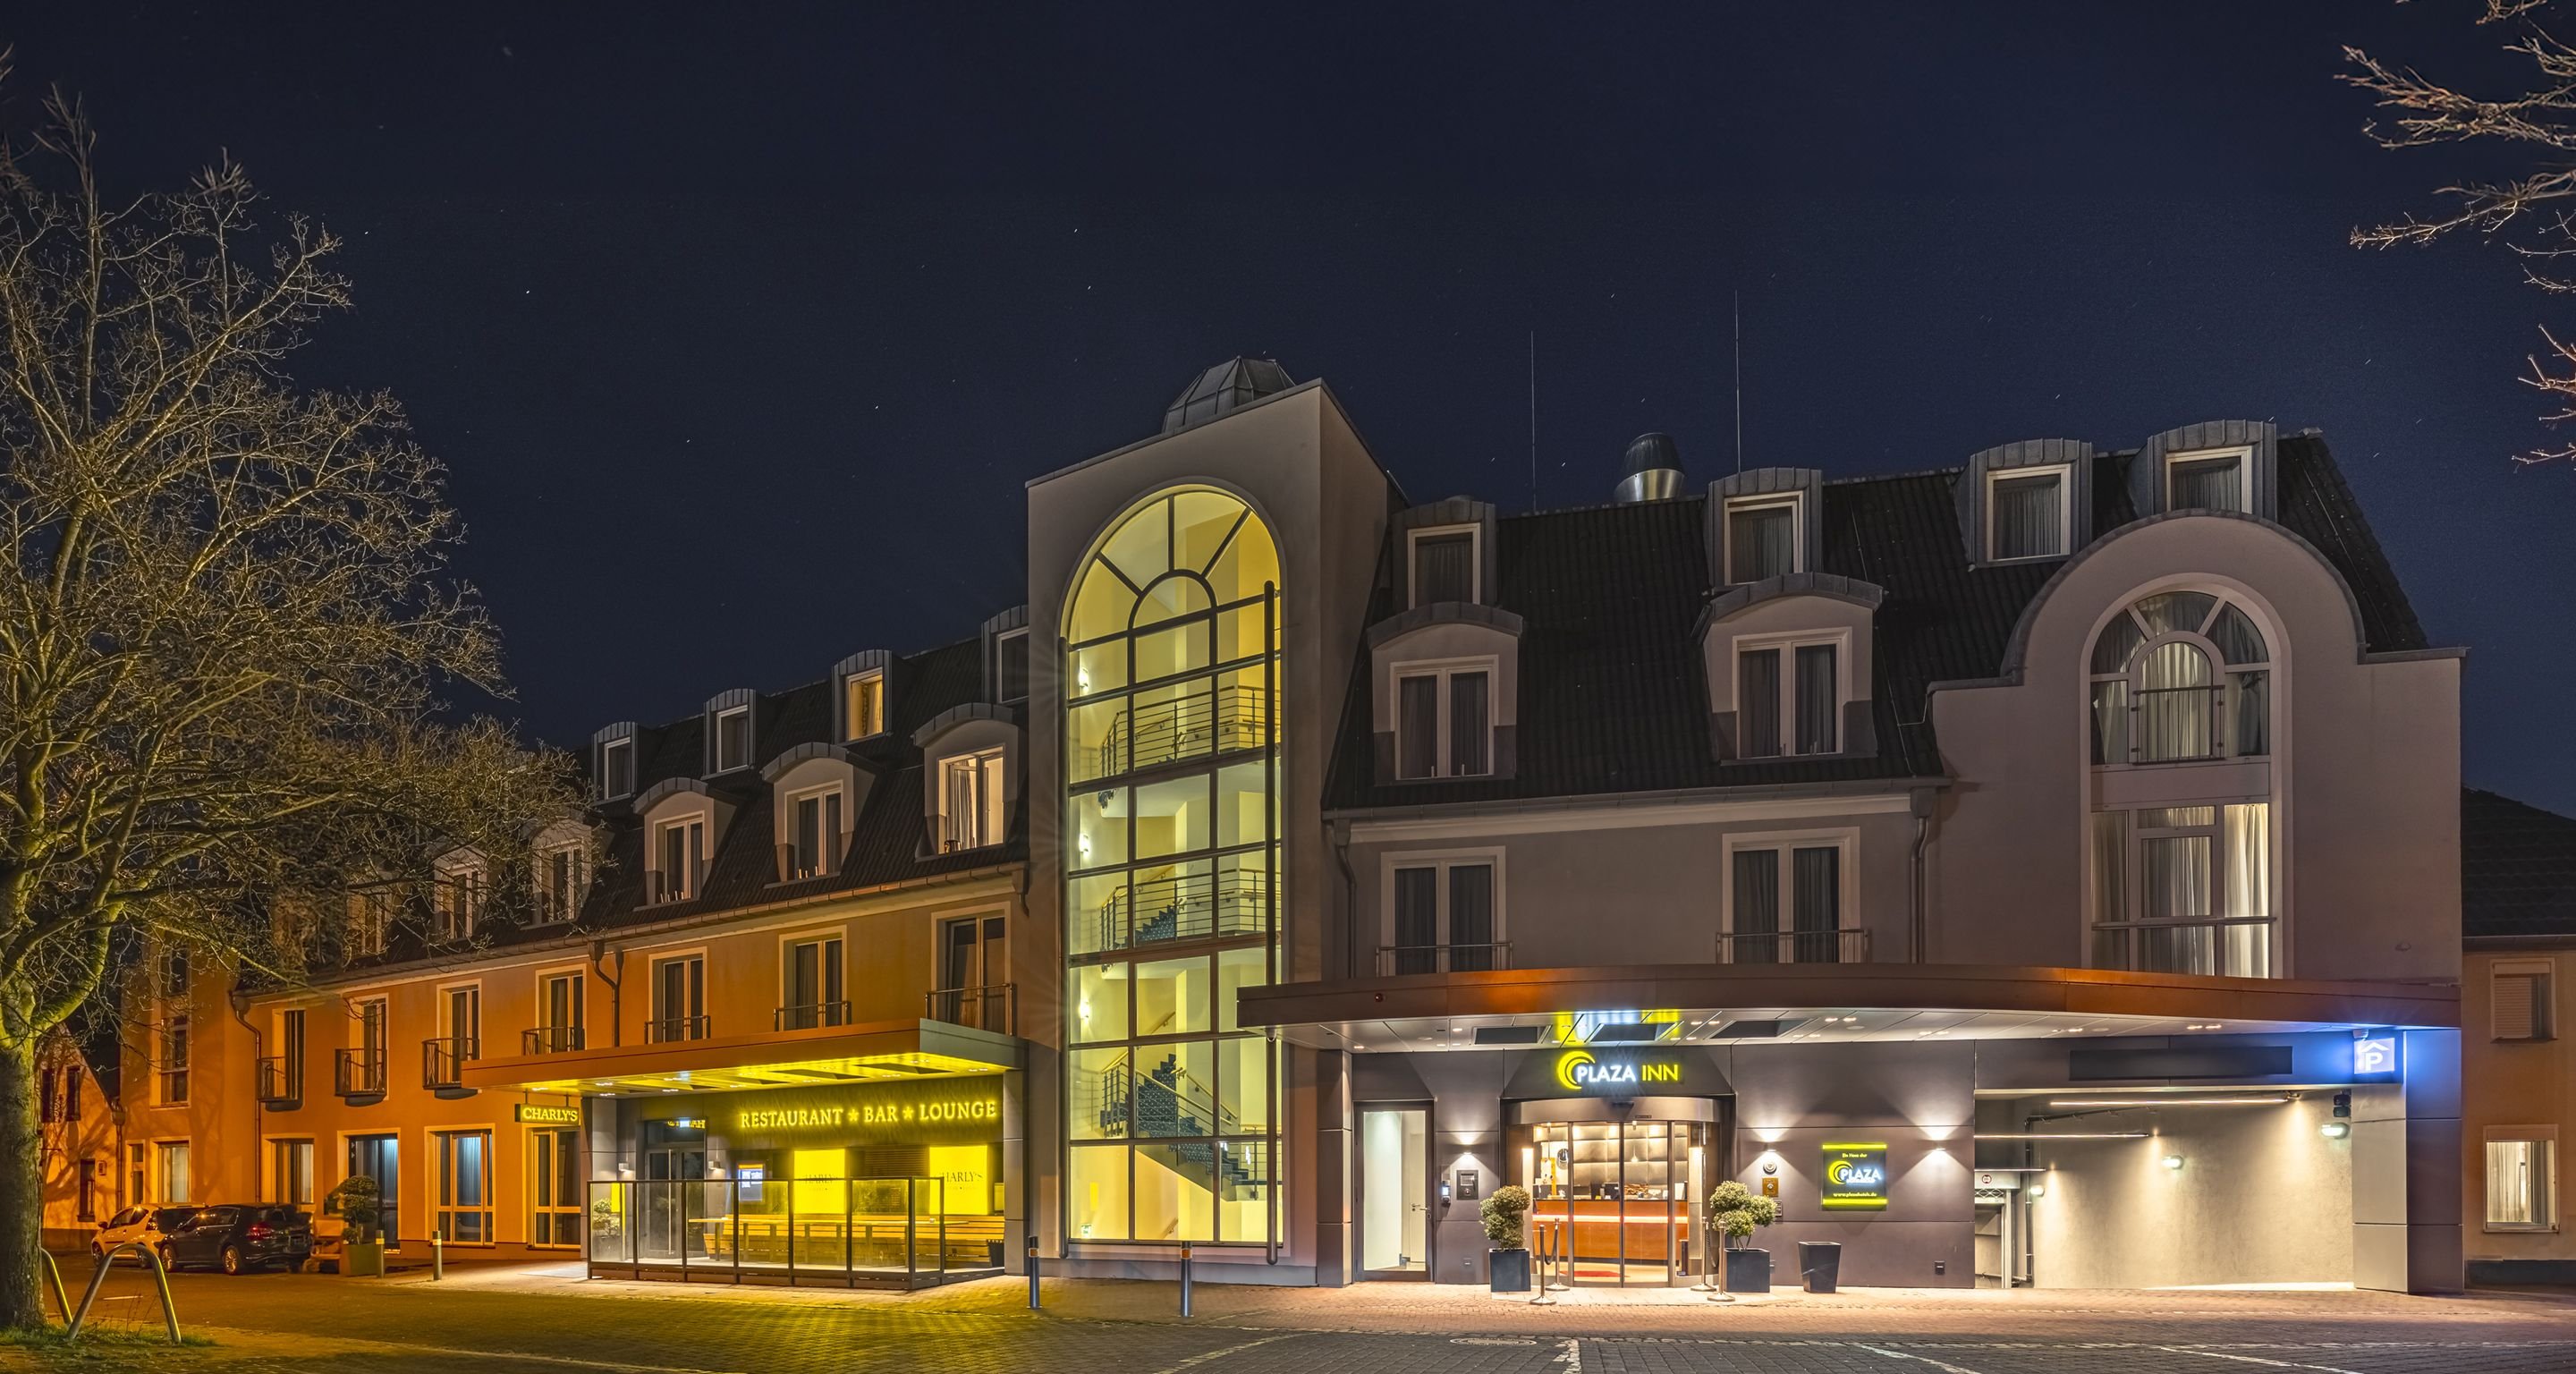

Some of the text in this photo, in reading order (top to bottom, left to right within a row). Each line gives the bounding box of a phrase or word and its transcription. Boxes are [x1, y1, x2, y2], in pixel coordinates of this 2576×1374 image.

[2365, 1052, 2384, 1071] P
[1576, 1064, 1679, 1083] PLAZA INN
[522, 1107, 578, 1122] CHARLY'S
[740, 1101, 996, 1128] RESTAURANT BAR LOUNGE
[1840, 1168, 1881, 1181] PLAZA
